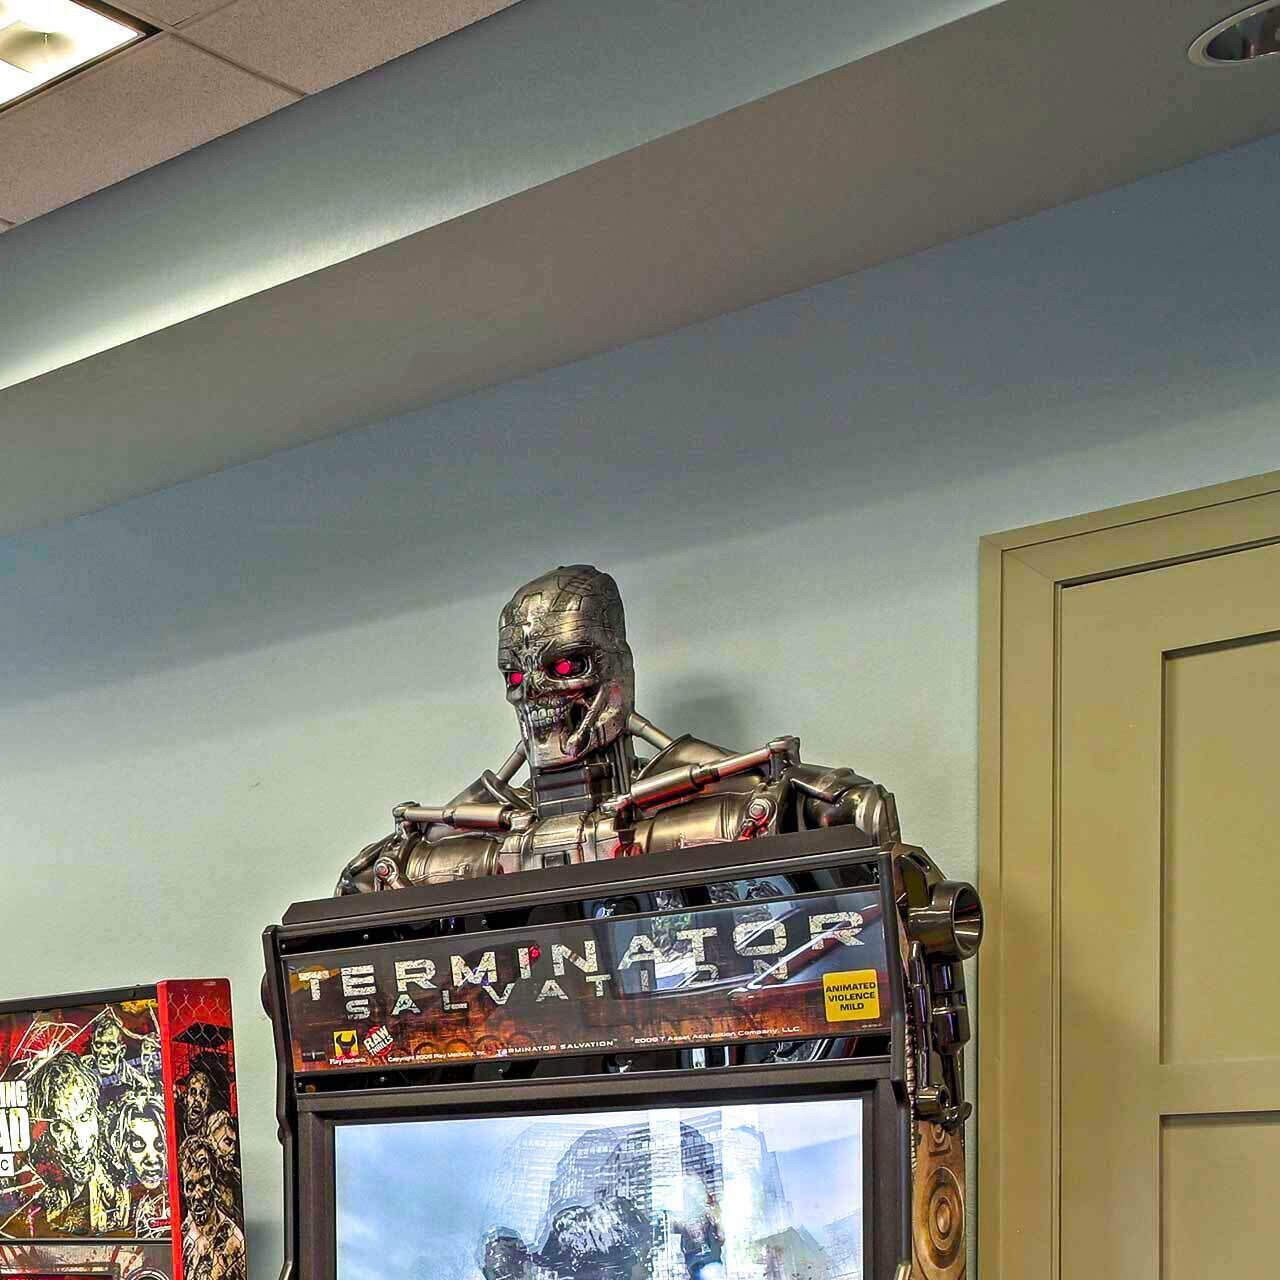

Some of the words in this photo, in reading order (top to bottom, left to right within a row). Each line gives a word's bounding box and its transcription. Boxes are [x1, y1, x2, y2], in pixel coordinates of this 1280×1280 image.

[298, 911, 865, 1001] TERMINATOR
[345, 957, 789, 1021] SALVATION
[825, 980, 877, 994] ANIMATED
[828, 990, 876, 1003] VIOLENCE
[840, 1001, 865, 1012] MILD
[363, 1025, 389, 1049] RAW
[692, 1030, 737, 1040] Acquisition
[496, 1043, 557, 1055] TERMINATOR
